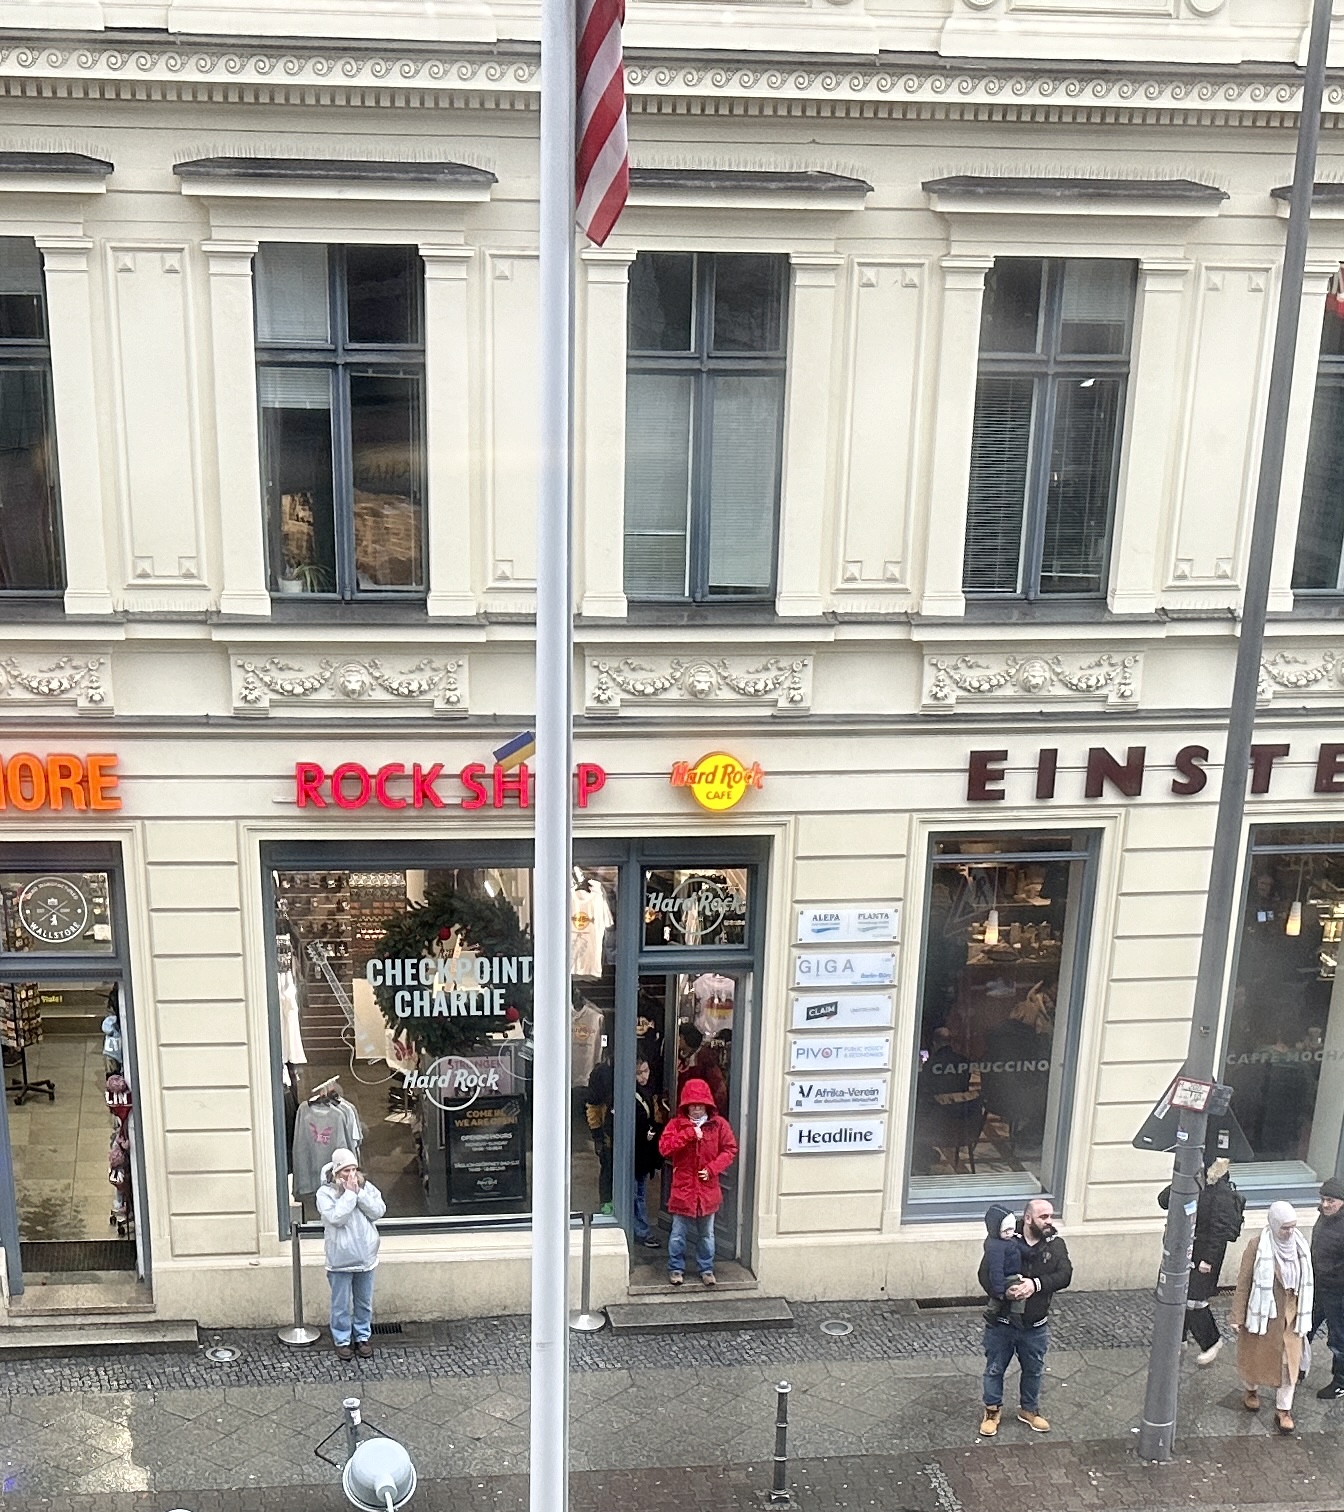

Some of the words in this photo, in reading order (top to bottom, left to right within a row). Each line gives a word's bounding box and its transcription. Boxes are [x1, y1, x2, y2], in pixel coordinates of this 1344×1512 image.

[670, 761, 719, 787] Hard
[720, 761, 763, 789] Rock
[295, 762, 446, 809] ROCK
[460, 762, 607, 809] SHP
[706, 791, 732, 800] CAFE
[646, 892, 697, 912] Hard
[698, 892, 745, 915] Rock
[30, 921, 80, 939] WALLSTORE
[366, 956, 533, 987] CHECKPOINT
[394, 988, 506, 1018] CHARLIE
[809, 1005, 836, 1017] CLAIM
[796, 1046, 843, 1059] PIVOT
[932, 1060, 1050, 1075] CAPPUCCINO
[403, 1069, 452, 1089] Hard
[454, 1068, 499, 1091] Rock
[815, 1087, 879, 1098] Afrika-Verein
[466, 1109, 492, 1118] COME
[455, 1119, 470, 1127] WE
[471, 1118, 489, 1126] ARE
[798, 1128, 873, 1144] Headline
